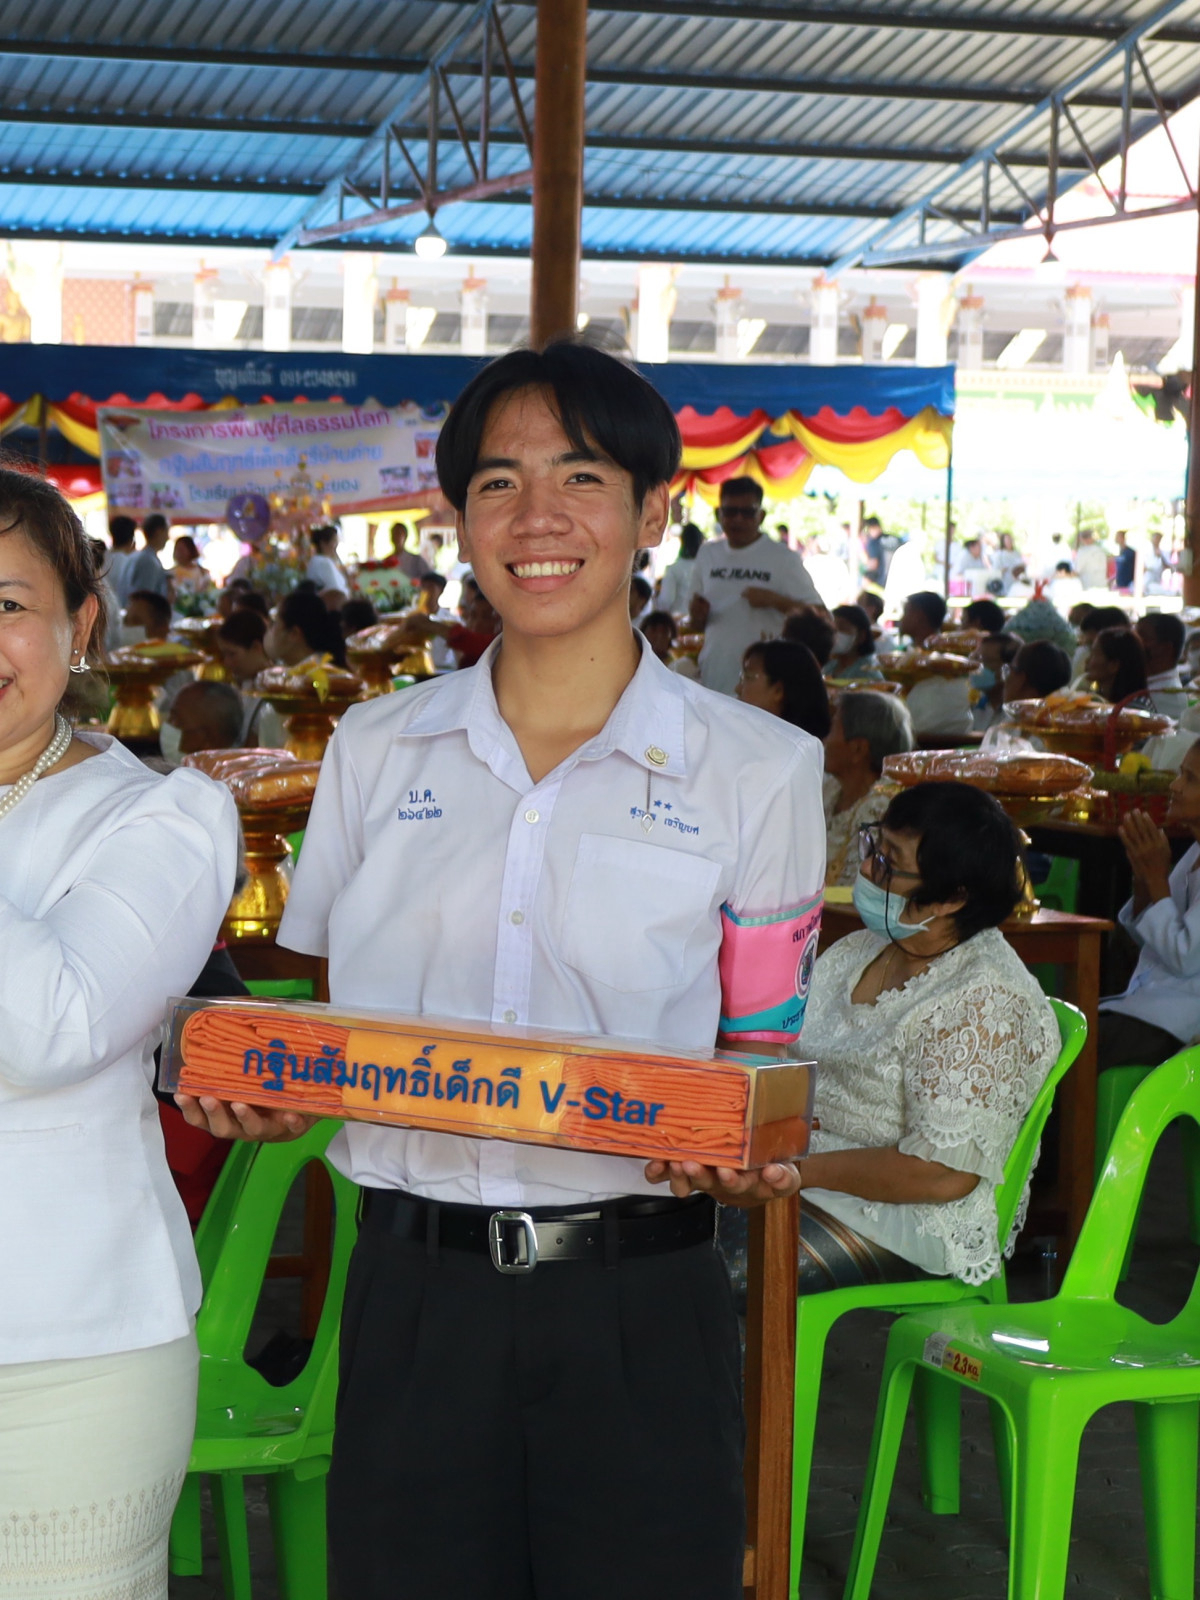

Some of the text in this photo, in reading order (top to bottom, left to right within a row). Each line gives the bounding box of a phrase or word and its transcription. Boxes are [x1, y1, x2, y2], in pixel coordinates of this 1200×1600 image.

[710, 567, 772, 582] MC JEANS
[242, 1040, 666, 1126] กฐินสัมฤทธิ์เด็กดี V-Star
